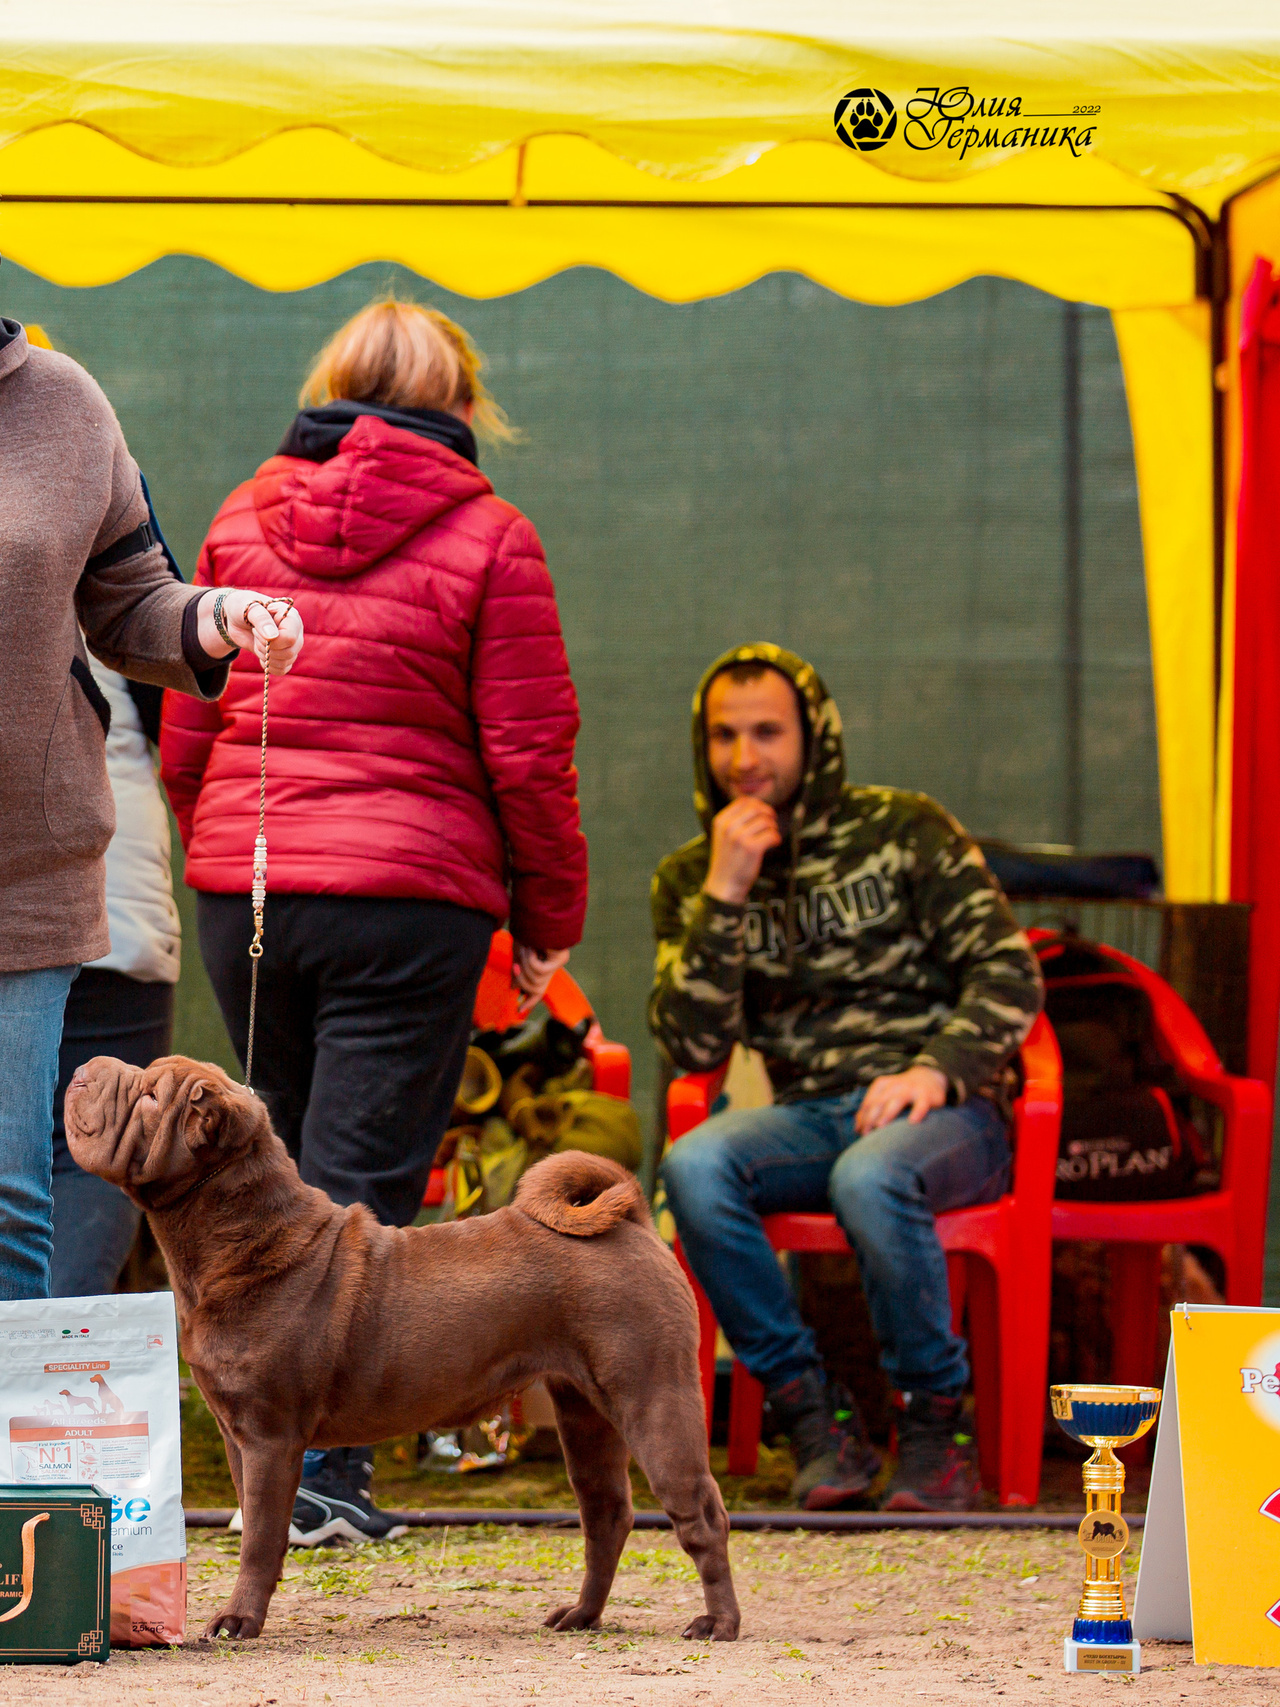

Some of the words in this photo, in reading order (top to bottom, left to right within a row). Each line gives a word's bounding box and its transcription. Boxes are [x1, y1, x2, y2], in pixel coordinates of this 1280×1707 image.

[741, 867, 892, 960] QUAD
[1056, 1155, 1089, 1181] RO
[48, 1363, 90, 1371] SPECIALITY
[64, 1429, 94, 1437] ADULT
[111, 1526, 152, 1536] emium
